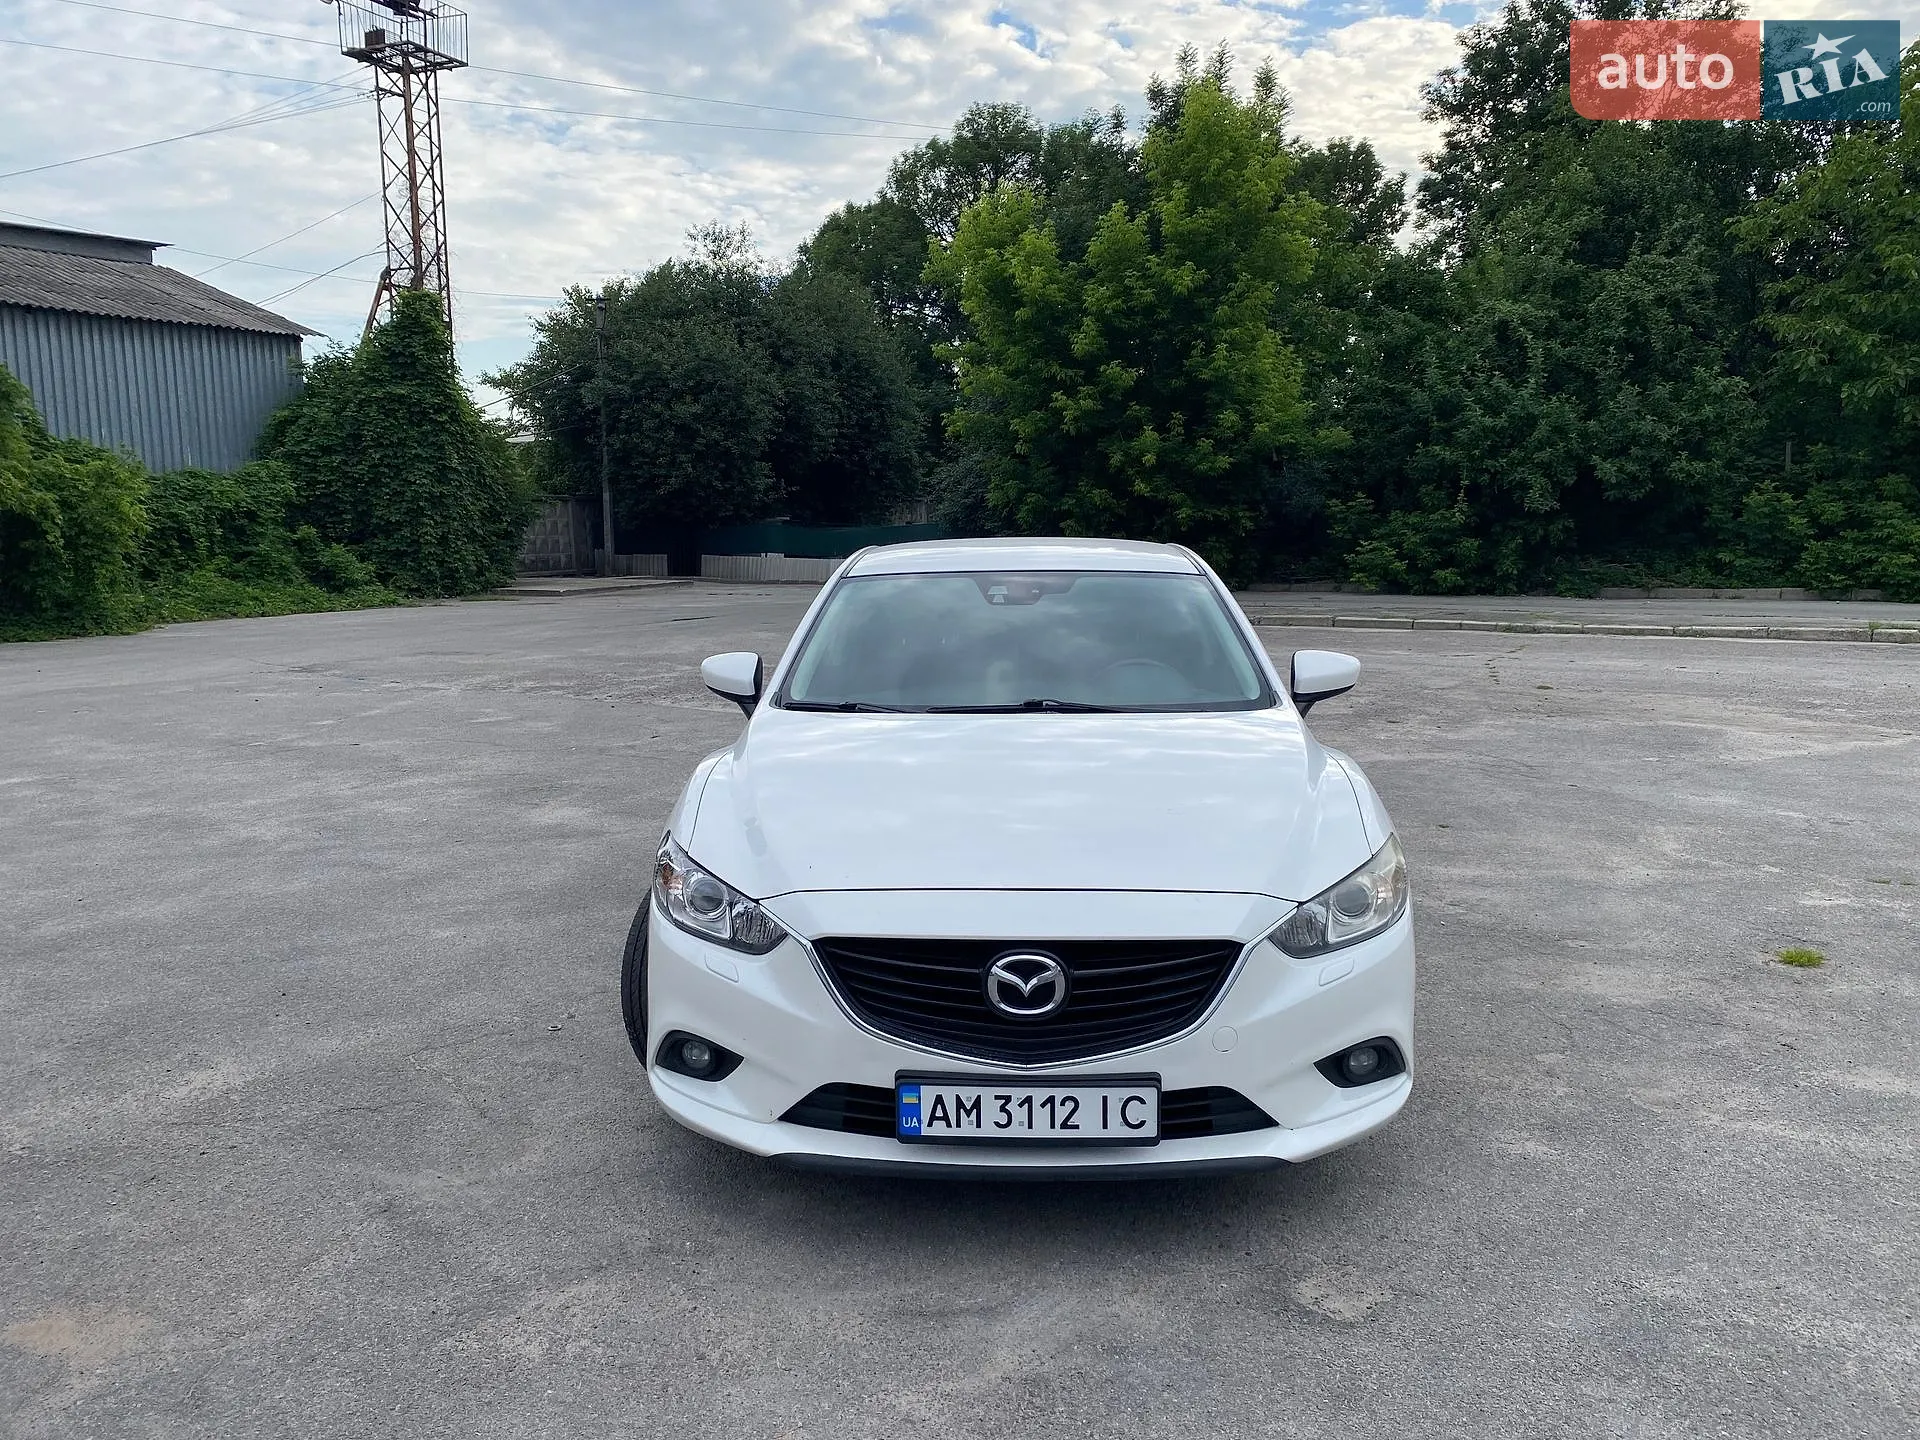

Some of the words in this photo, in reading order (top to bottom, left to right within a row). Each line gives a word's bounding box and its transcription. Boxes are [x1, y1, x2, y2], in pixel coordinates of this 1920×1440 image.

[903, 1116, 919, 1128] UA
[927, 1094, 982, 1128] AM
[993, 1095, 1080, 1130] 3112
[1101, 1095, 1147, 1130] IC
